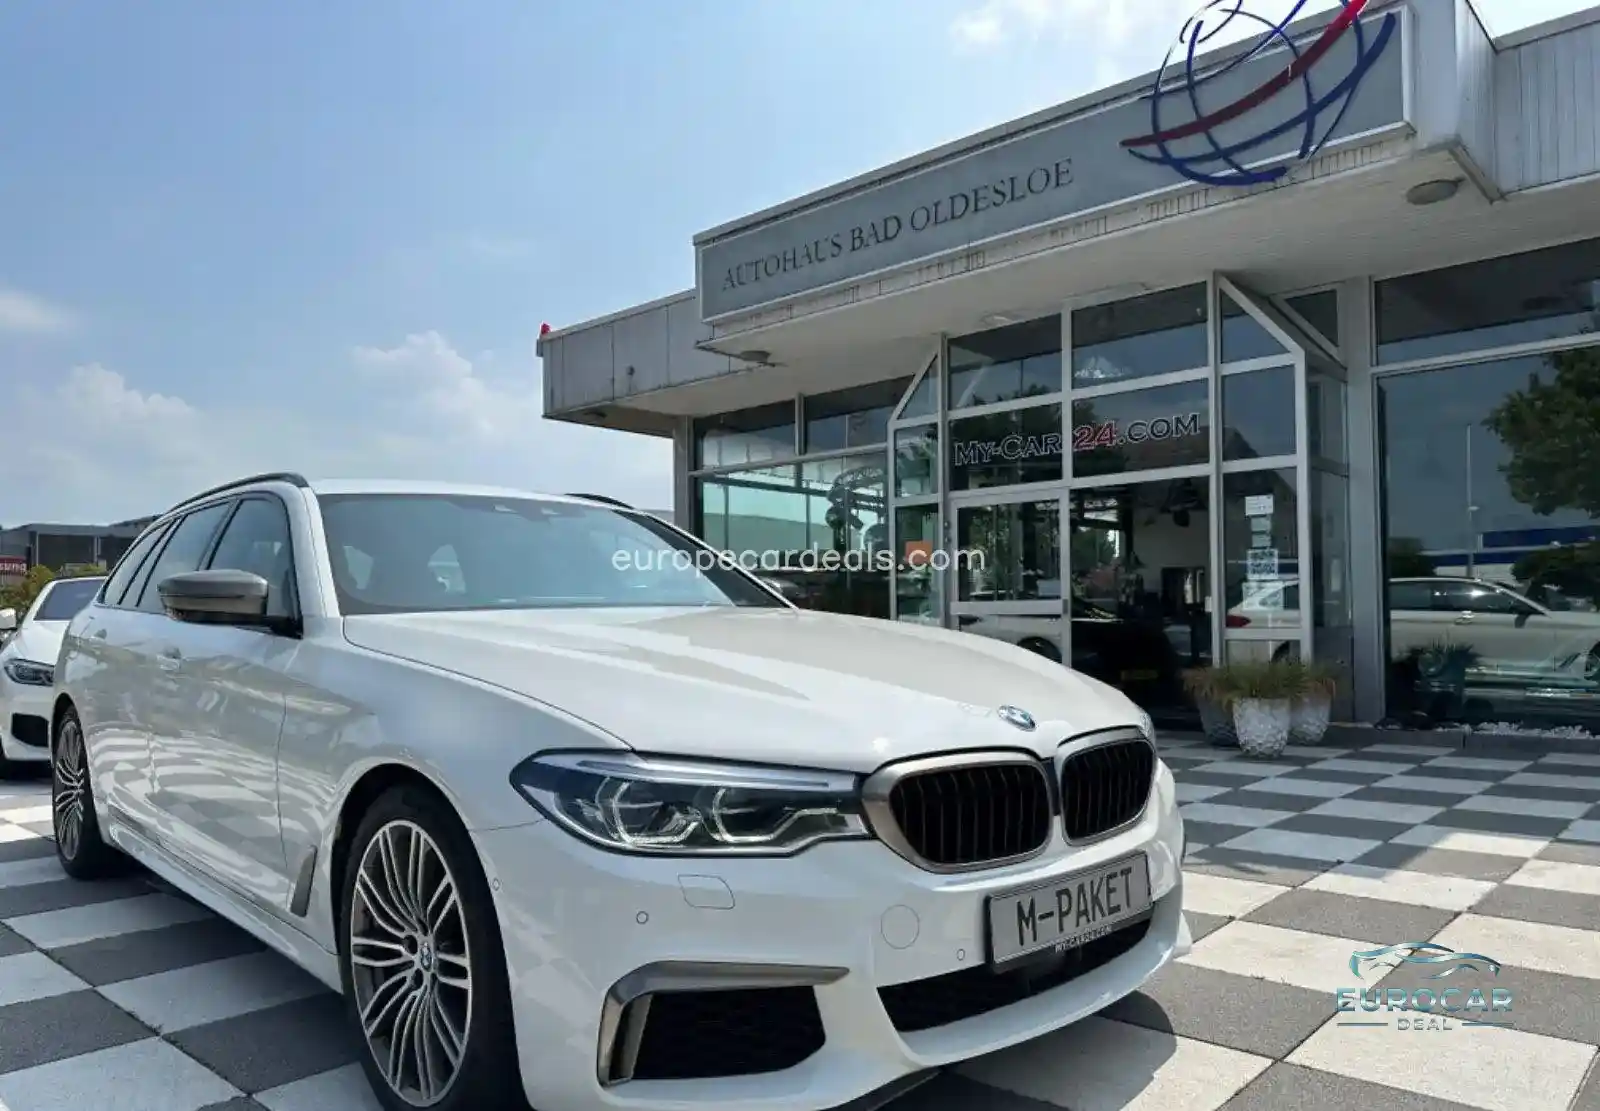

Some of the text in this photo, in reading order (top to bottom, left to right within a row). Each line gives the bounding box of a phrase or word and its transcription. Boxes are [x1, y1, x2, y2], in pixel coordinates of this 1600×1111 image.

[722, 157, 1075, 291] AUTOHAUS BAD OLDESLOE
[1017, 866, 1132, 946] M-PAKET
